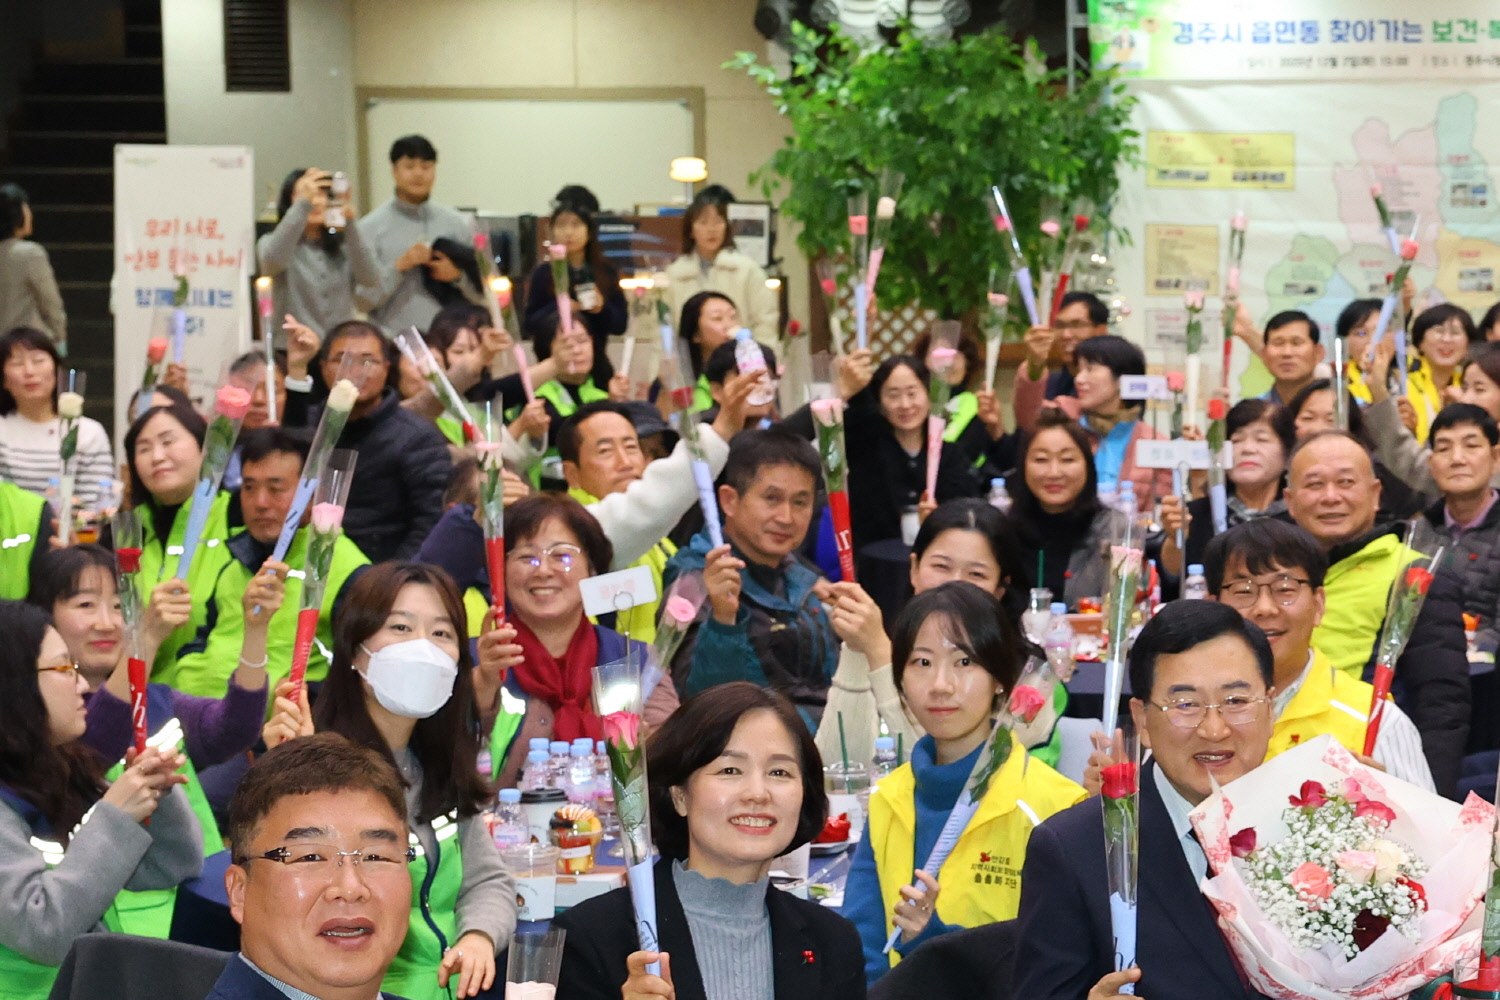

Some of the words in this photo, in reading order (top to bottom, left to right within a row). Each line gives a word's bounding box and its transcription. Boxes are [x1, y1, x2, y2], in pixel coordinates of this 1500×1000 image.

[1172, 20, 1242, 44] 경주시
[1252, 20, 1320, 44] 읍면동
[1330, 19, 1422, 43] 찾아가는
[146, 216, 180, 237] 우리
